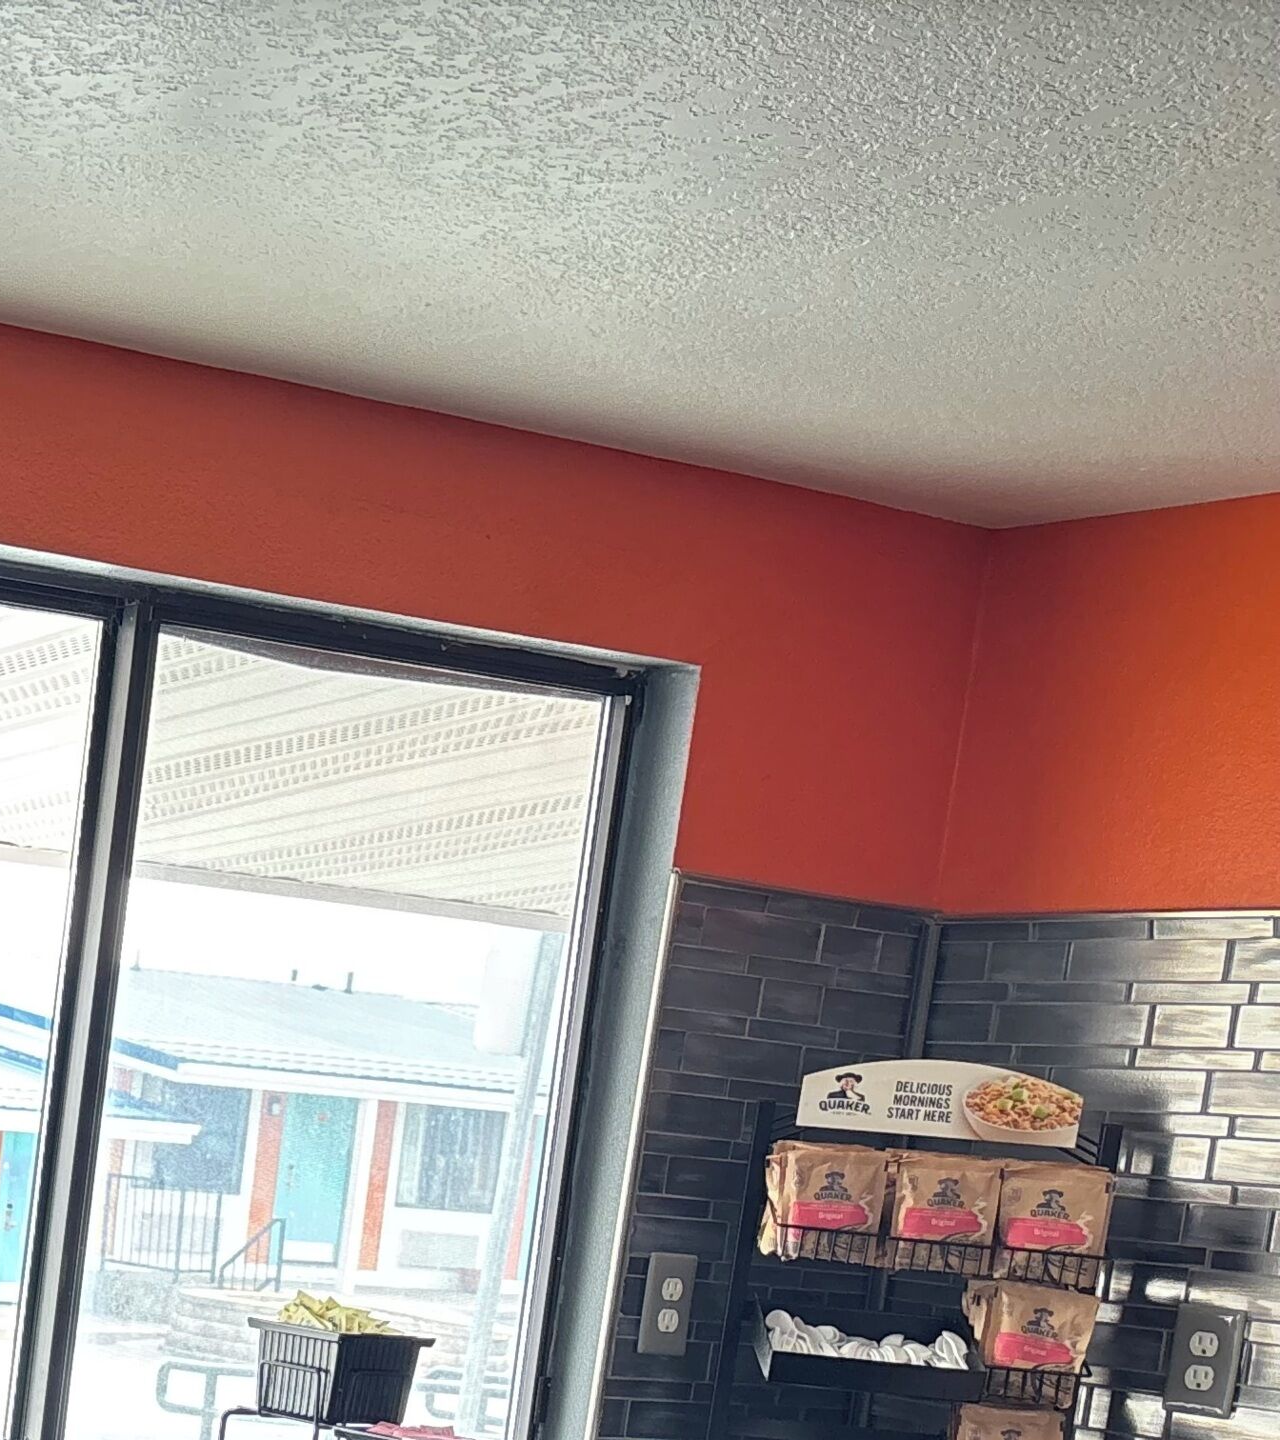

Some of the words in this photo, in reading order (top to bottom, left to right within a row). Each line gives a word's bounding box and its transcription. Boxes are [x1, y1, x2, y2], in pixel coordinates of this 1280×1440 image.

[895, 1080, 953, 1097] DELICIOUS
[819, 1099, 871, 1115] QUAKER
[893, 1094, 951, 1109] MORNINGS
[886, 1106, 921, 1121] START
[923, 1109, 953, 1124] HERE
[813, 1192, 852, 1202] QUAKER
[927, 1199, 965, 1209] QUAKER
[1030, 1208, 1070, 1220] QUAKER
[1020, 1325, 1059, 1339] QUAKER
